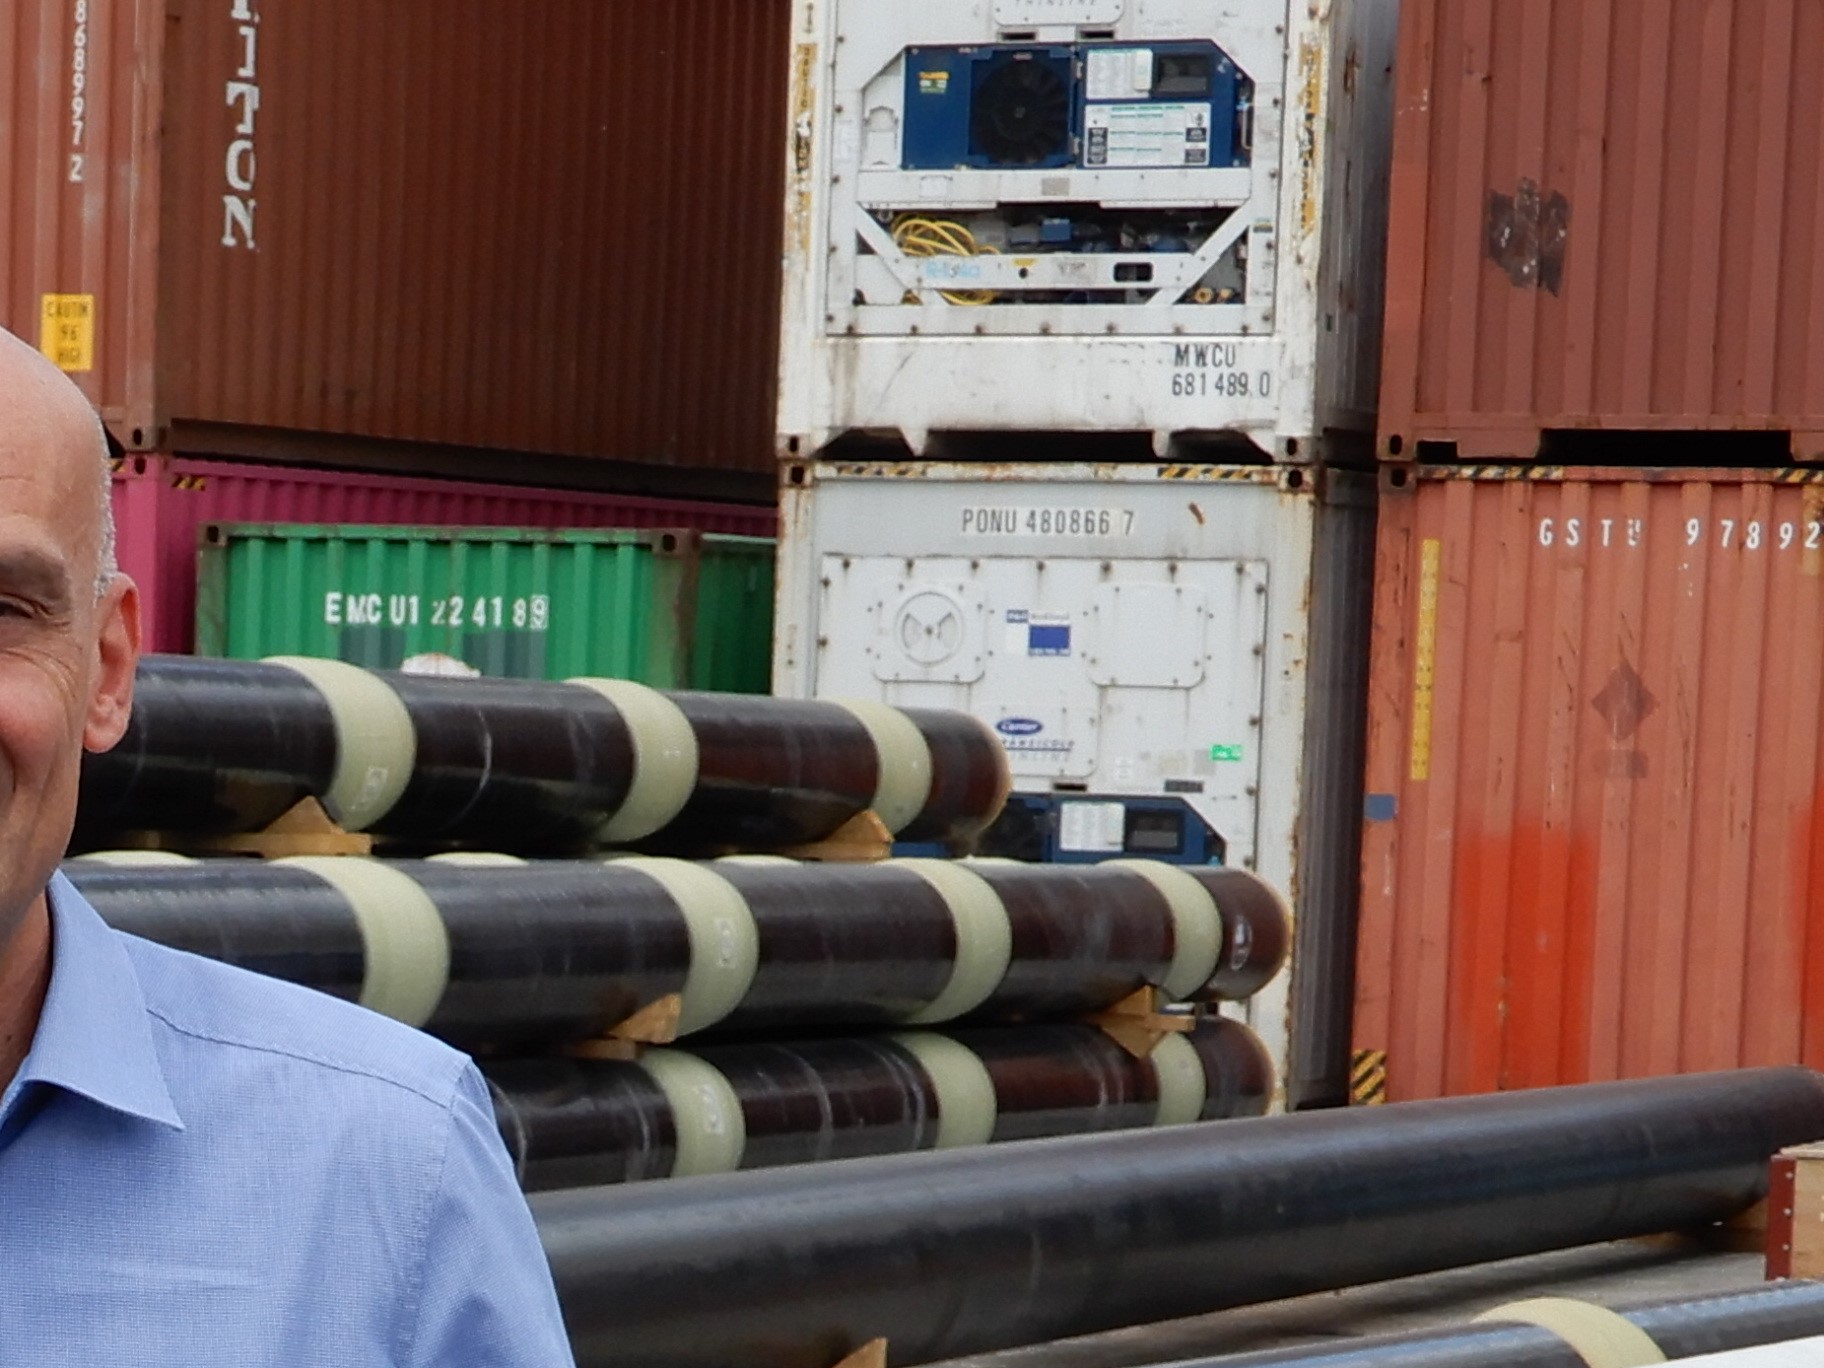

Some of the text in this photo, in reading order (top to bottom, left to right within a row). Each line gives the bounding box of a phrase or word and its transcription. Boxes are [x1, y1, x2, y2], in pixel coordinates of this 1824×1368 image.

[69, 153, 84, 182] 2
[1174, 343, 1236, 368] MWCU
[1172, 371, 1271, 397] 681 489 0
[962, 508, 1134, 537] PONU 480866 7
[1686, 518, 1821, 550] 97892
